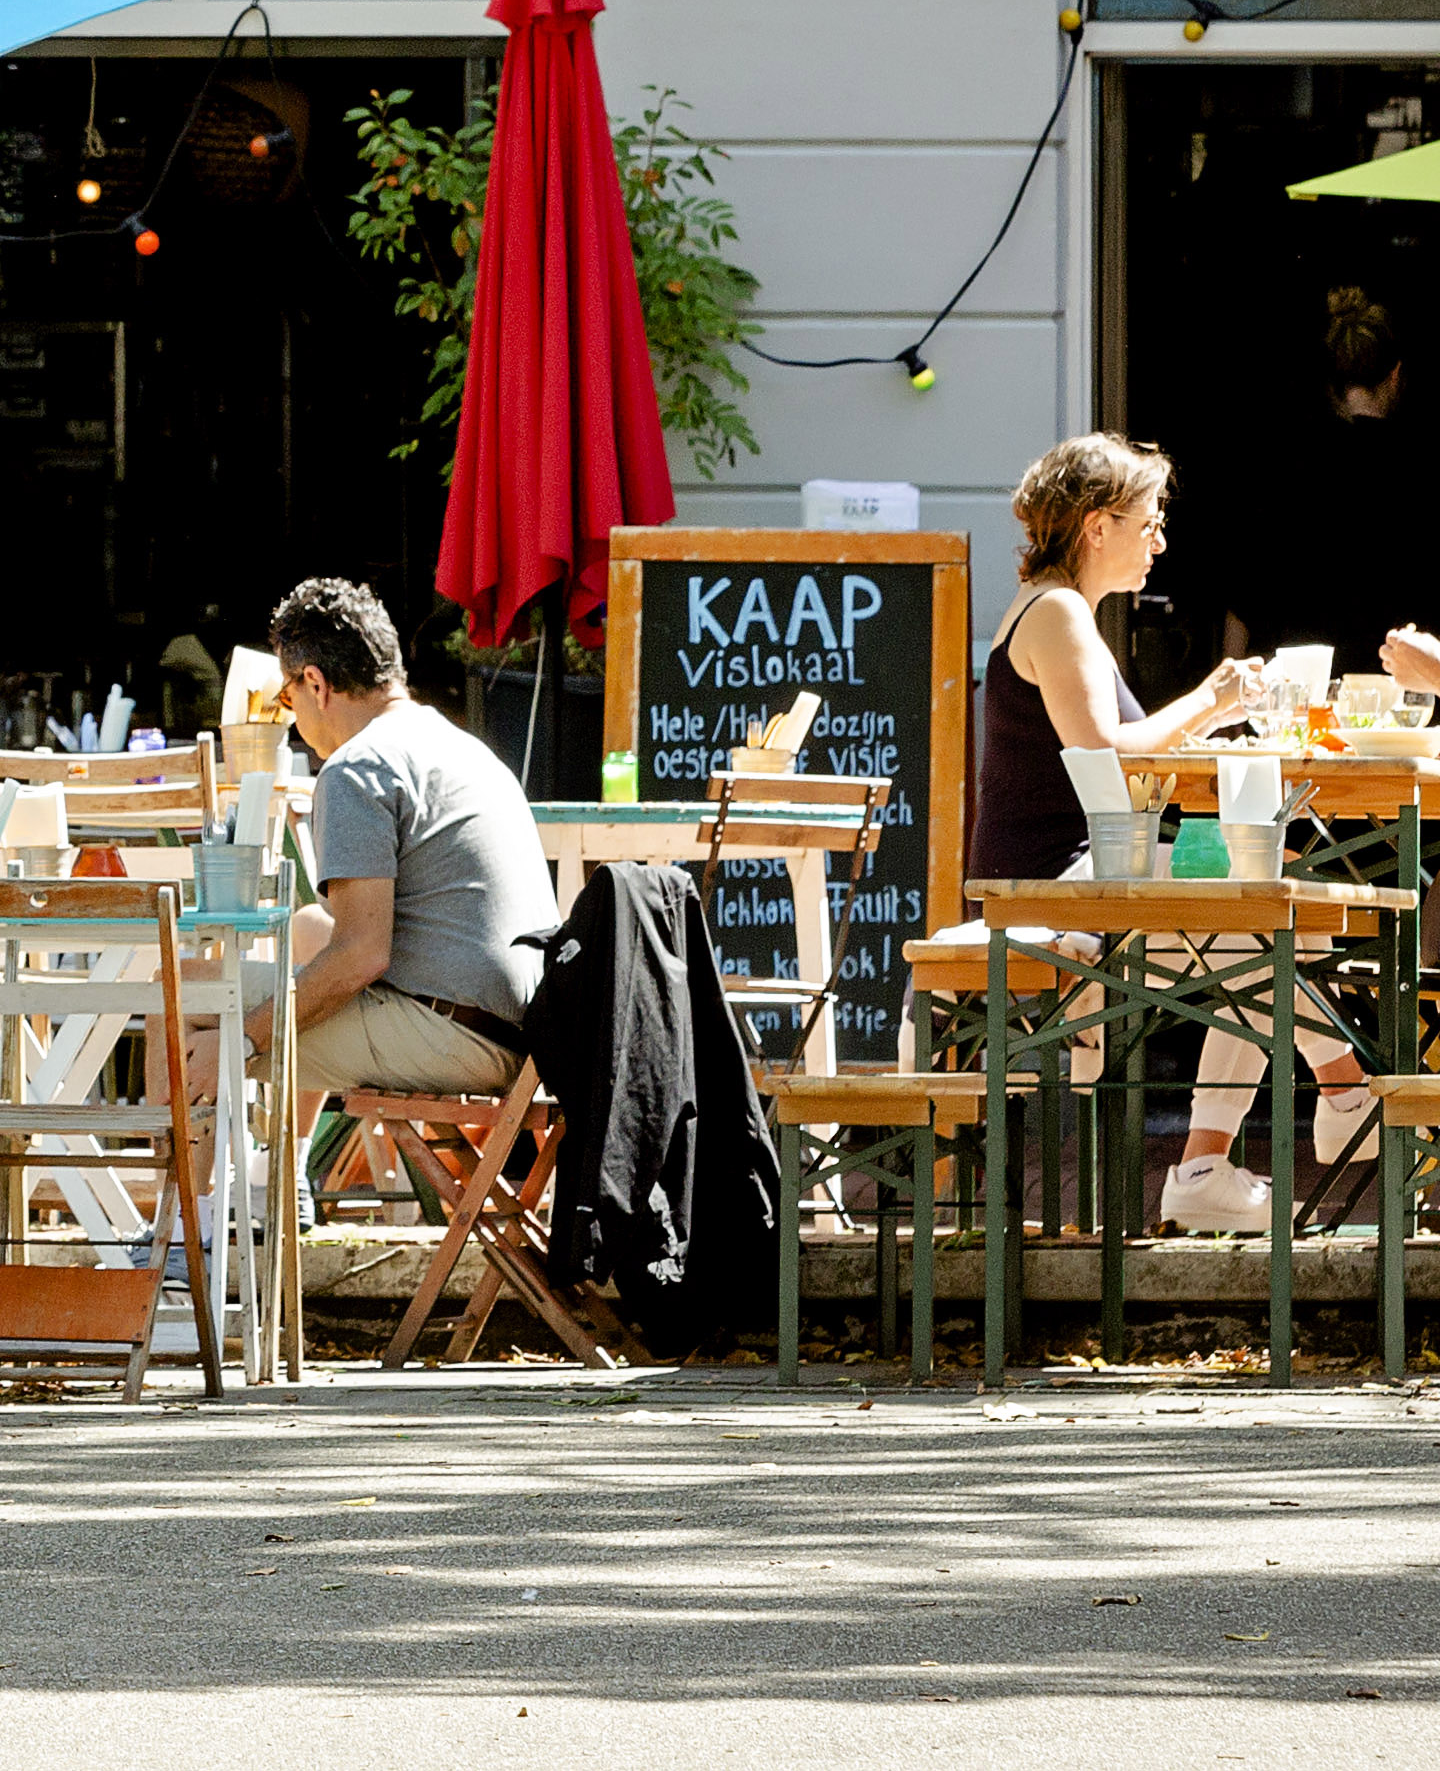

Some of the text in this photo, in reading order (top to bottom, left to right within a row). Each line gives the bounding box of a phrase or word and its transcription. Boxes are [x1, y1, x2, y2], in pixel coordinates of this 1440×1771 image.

[688, 575, 883, 649] KAAP
[678, 645, 865, 687] Vislokaal
[650, 704, 705, 743] Hele
[813, 699, 895, 745] dozijn
